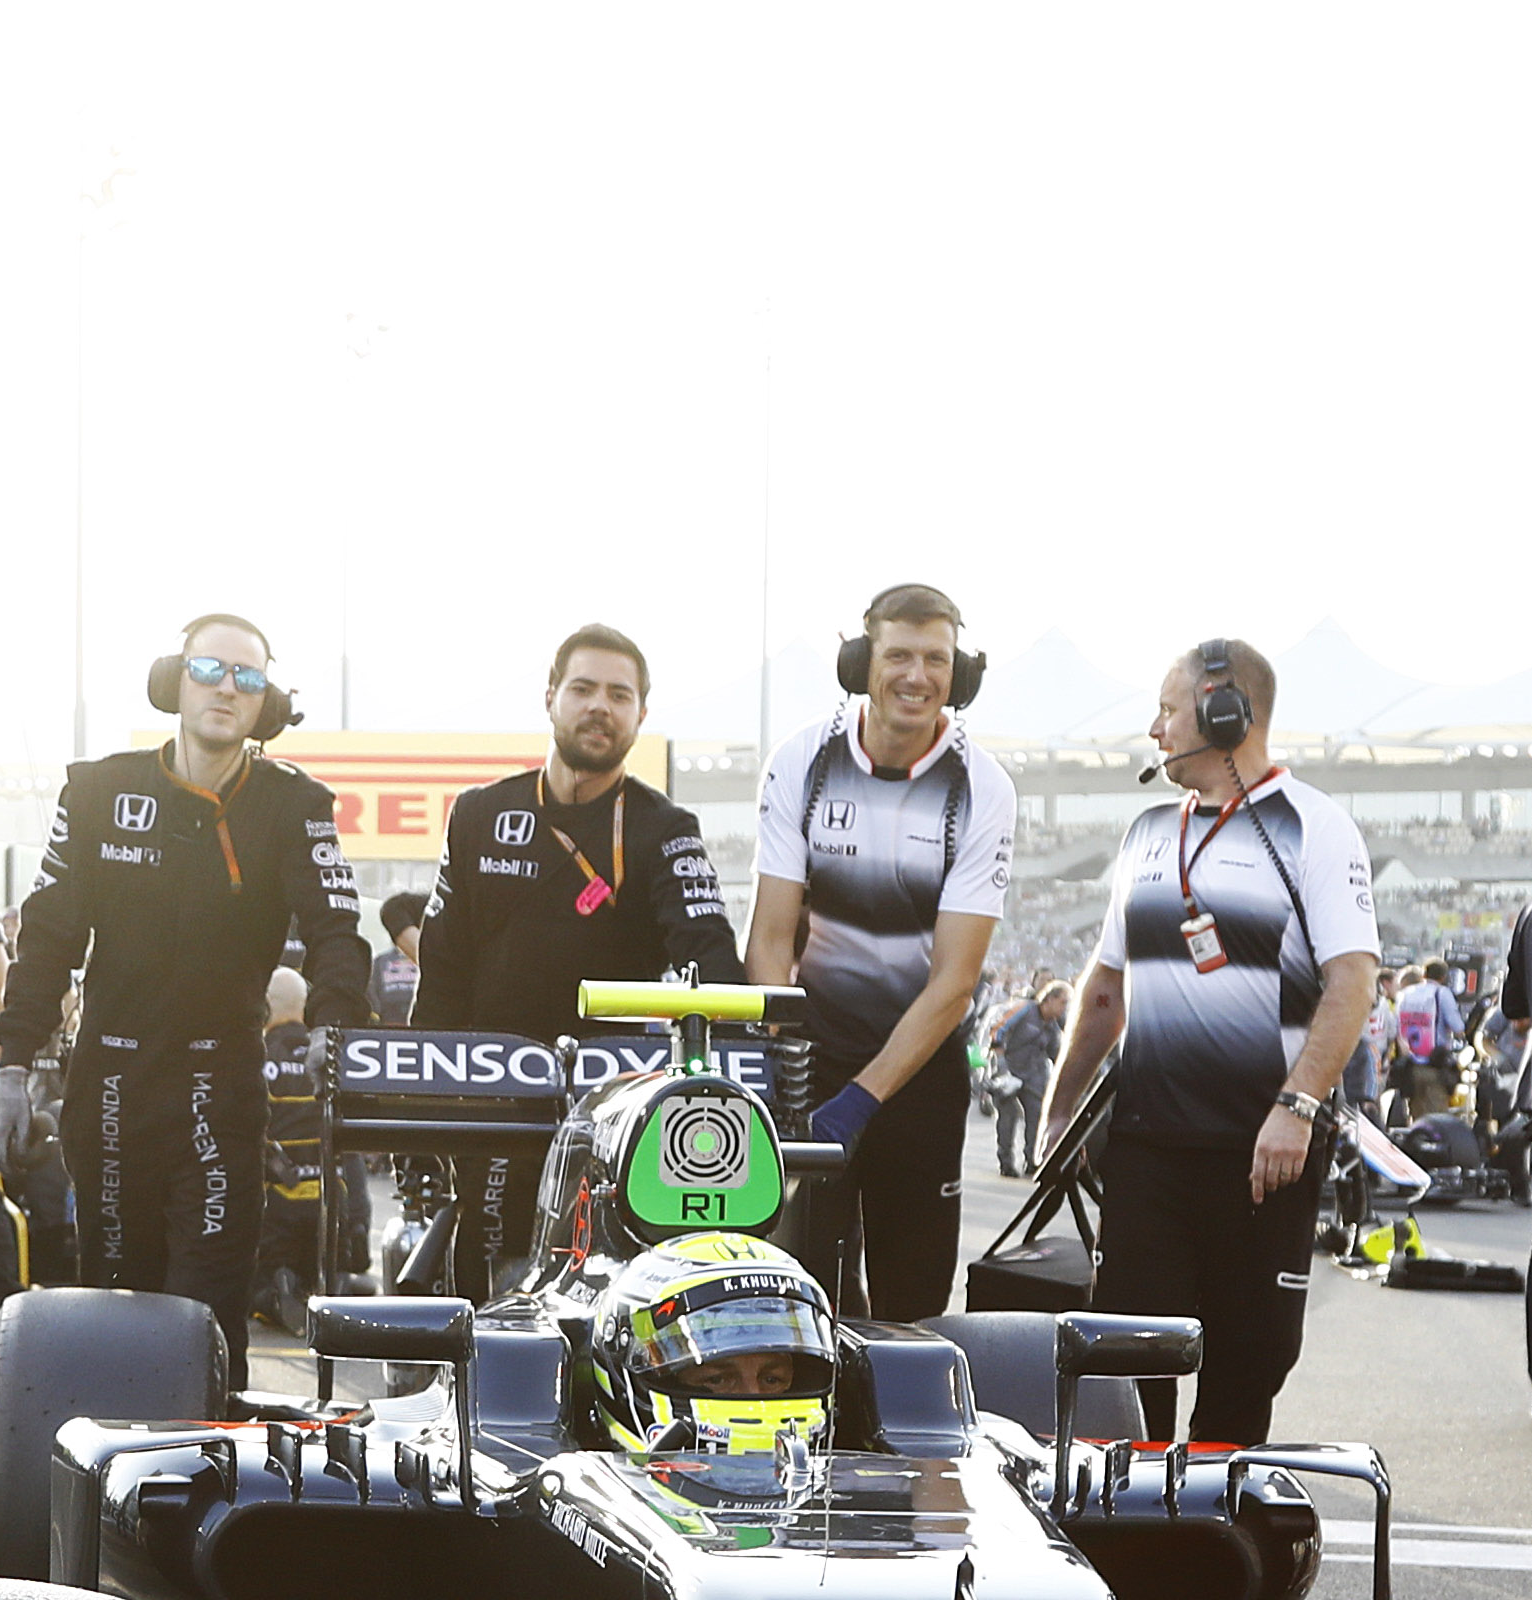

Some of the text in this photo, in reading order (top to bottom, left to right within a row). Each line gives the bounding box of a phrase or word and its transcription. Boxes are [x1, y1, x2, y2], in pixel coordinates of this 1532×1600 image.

[101, 842, 143, 863] Mobil
[813, 842, 844, 855] Mobil
[479, 856, 519, 876] Mobil
[345, 1039, 768, 1090] SENSODYE
[101, 1075, 122, 1151] HONDA
[192, 1072, 220, 1162] McLREN
[202, 1165, 228, 1235] HONDA
[682, 1193, 726, 1220] R1
[723, 1274, 802, 1293] K. KHULLAR
[698, 1424, 730, 1438] Mobil
[551, 1499, 607, 1568] RICHARD MILLE
